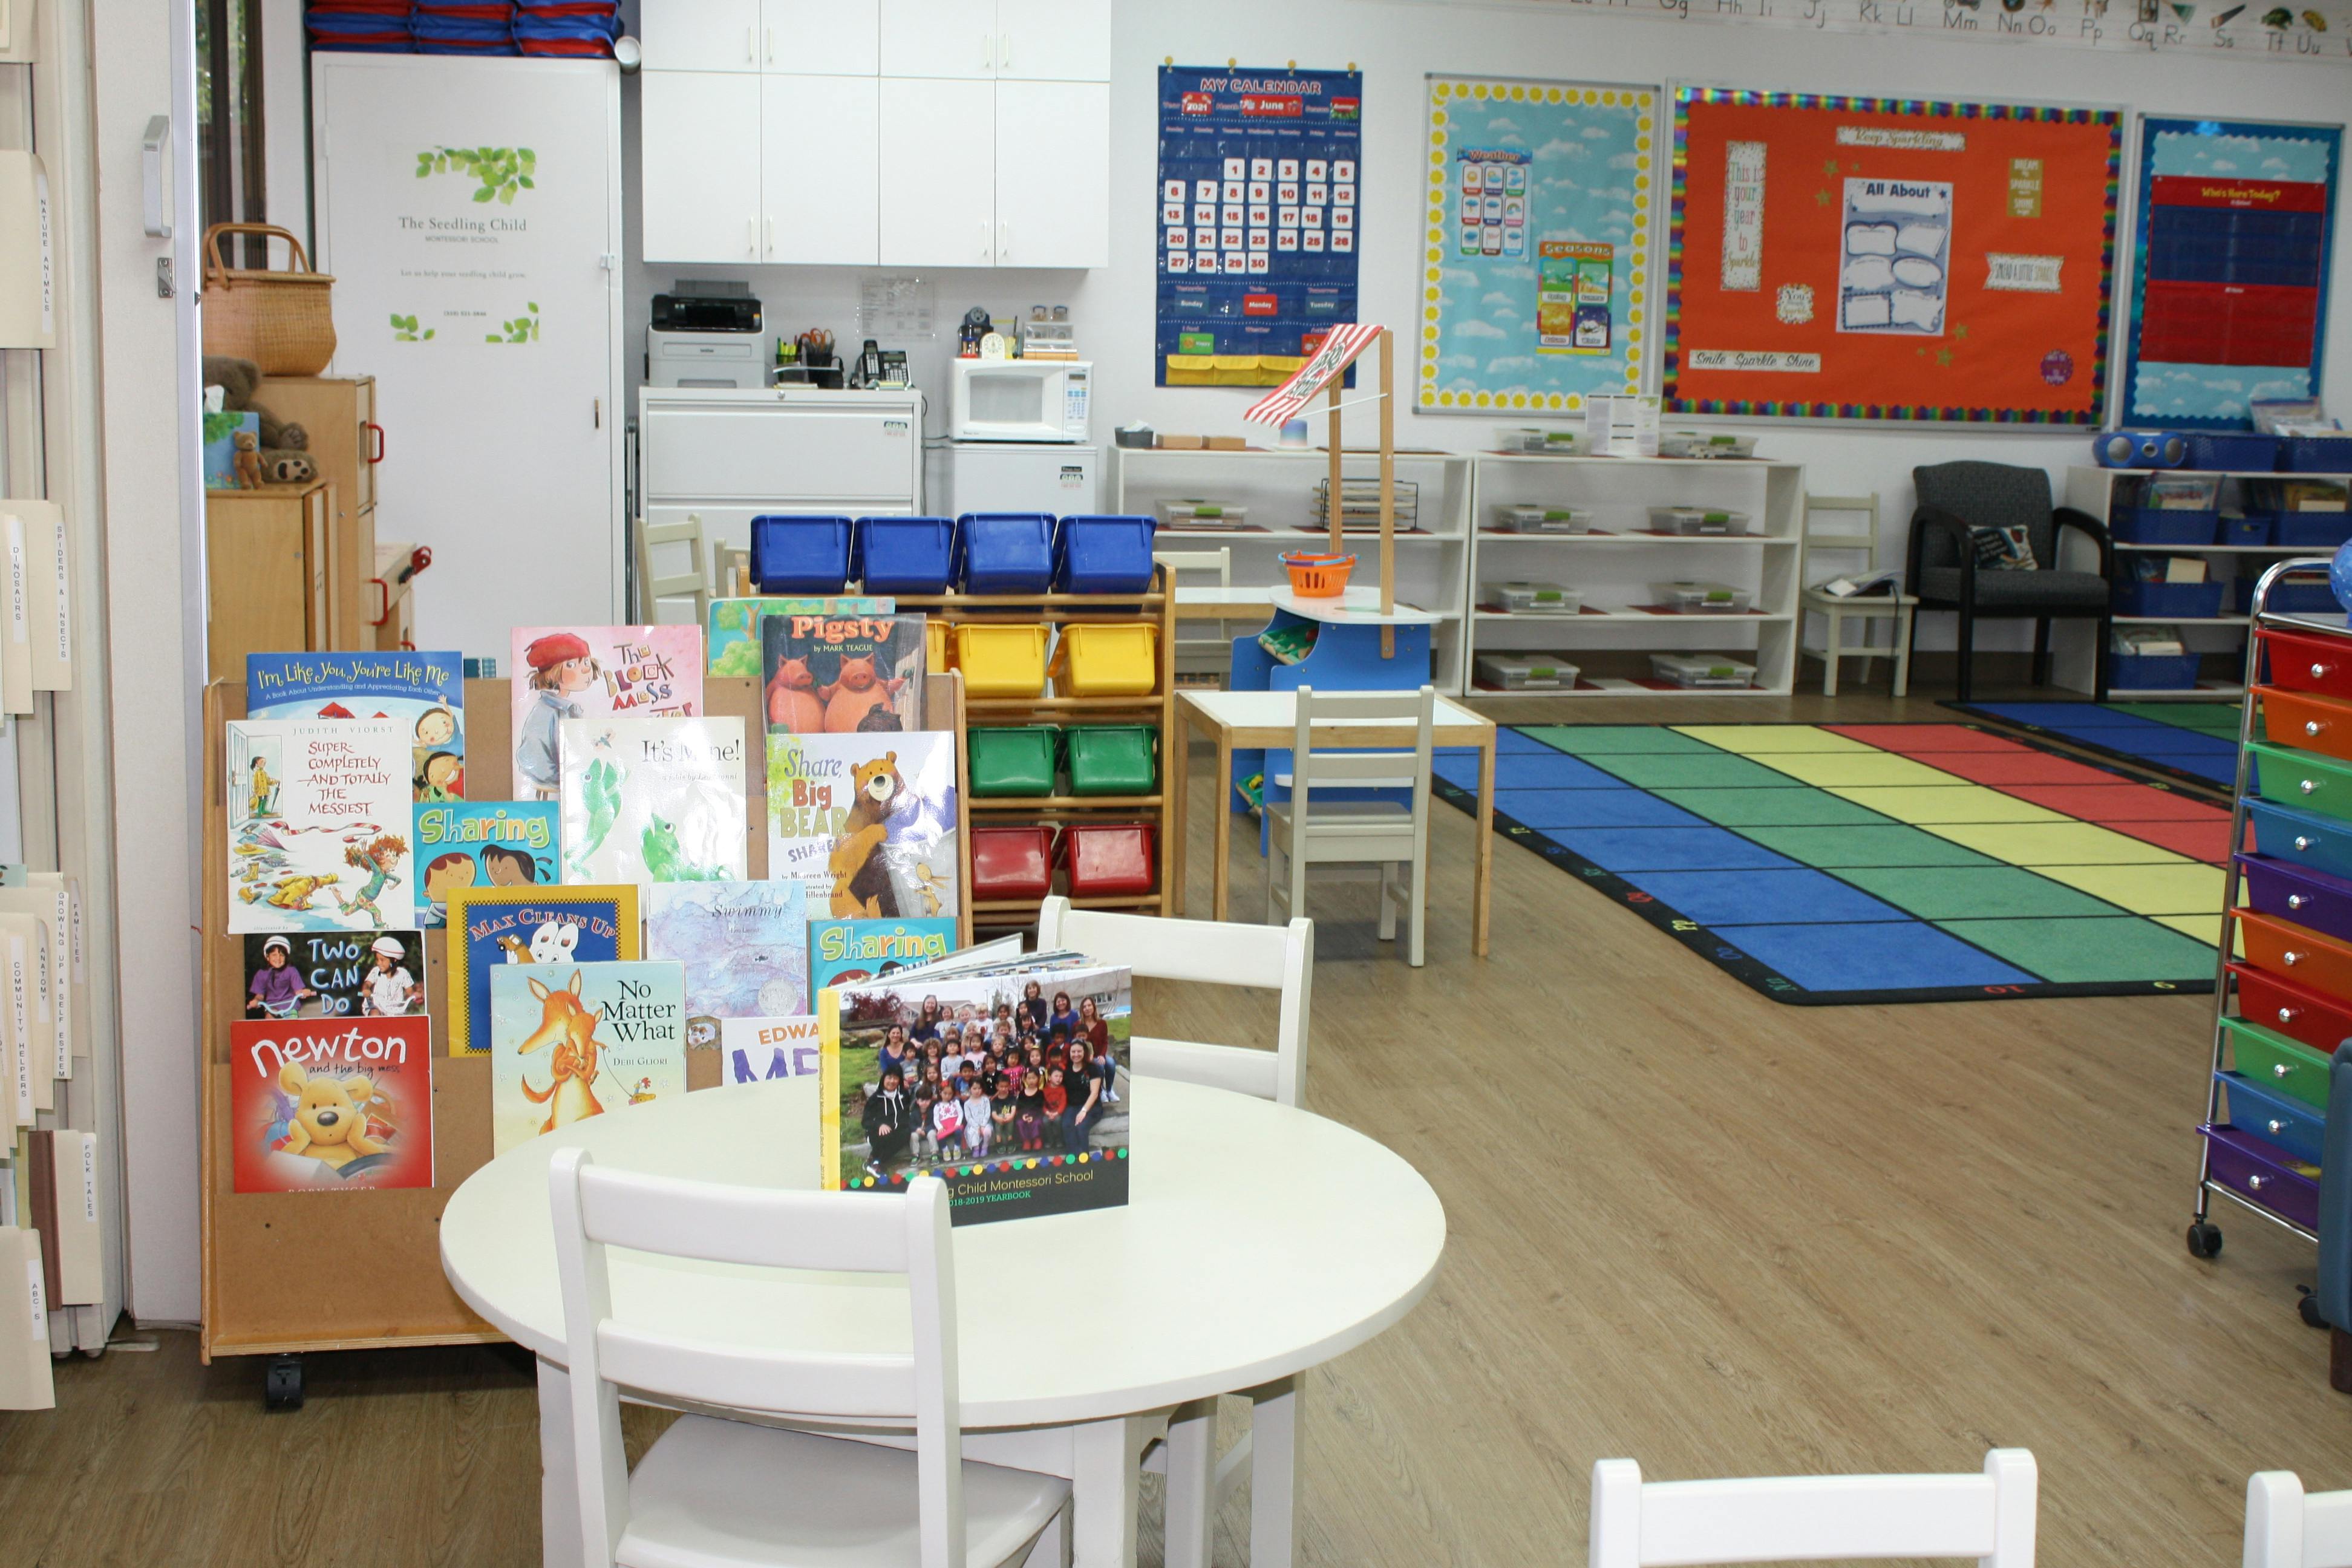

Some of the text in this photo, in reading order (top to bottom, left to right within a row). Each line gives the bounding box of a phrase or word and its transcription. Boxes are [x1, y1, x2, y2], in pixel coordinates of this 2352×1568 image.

[1859, 2, 1882, 23] Kk
[1942, 11, 1978, 30] Mm
[1998, 14, 2022, 33] Nn
[2028, 16, 2056, 36] Oo
[2080, 19, 2103, 46] Pp
[2129, 22, 2157, 51] Qq
[2163, 24, 2187, 45] Rr
[2213, 28, 2234, 48] Ss
[2265, 31, 2284, 51] Tt
[2298, 34, 2321, 55] Uu
[1200, 78, 1321, 94] MY CALENDAR
[1186, 101, 1284, 112] 2021 June
[1887, 131, 1944, 147] Sparkling
[1469, 151, 1520, 161] Weather
[1232, 165, 1348, 176] 1 2 3 4 5
[1171, 187, 1350, 200] 6 7 8 9 10 11 12
[1734, 185, 1757, 207] your
[1866, 183, 1930, 198] All About
[2201, 188, 2227, 197] Who's
[2228, 188, 2247, 198] Here
[2249, 189, 2281, 203] Today?
[1167, 210, 1348, 223] 13 14 15 16 17 18 19
[1734, 209, 1754, 231] year
[399, 217, 527, 234] The Seedling Child
[1170, 235, 1348, 246] 20 21 22 23 24 25 26
[1739, 232, 1748, 252] to
[1546, 244, 1612, 255] Seasons
[1171, 258, 1265, 268] 27 28 29 30
[1181, 299, 1334, 310] Sunday Monday Tuesday
[1695, 351, 1815, 370] Smile Sparkle Shine
[13, 547, 22, 621] DINOSAURS
[791, 616, 895, 644] Pigsty
[613, 643, 651, 665] The
[258, 661, 450, 689] I'm Like You, You're Like Me
[289, 688, 307, 697] About
[308, 684, 353, 693] Understanding
[367, 683, 407, 692] Appreciating
[293, 727, 339, 736] JUDITH
[308, 741, 354, 756] SUPER-
[641, 740, 673, 762] It's
[308, 756, 381, 771] COMPLETELY
[785, 748, 843, 779] Share,
[298, 773, 392, 786] AND TOTALLY
[319, 789, 347, 800] THE
[792, 780, 832, 811] Big
[308, 802, 374, 816] MESSIEST
[419, 808, 551, 849] Sharing
[779, 807, 848, 838] BEAR
[823, 871, 846, 880] Wright
[712, 904, 783, 920] Swimmy
[469, 908, 616, 942] MAX CLEANS UP
[307, 939, 362, 963] TWO
[820, 927, 947, 961] Sharing
[58, 955, 65, 969] UP
[310, 966, 361, 990] CAN
[14, 962, 24, 1033] COMMUNITY
[618, 980, 652, 1001] No
[321, 994, 351, 1014] DO
[602, 1001, 676, 1022] Matter
[612, 1021, 676, 1042] What
[251, 1027, 407, 1078] newton
[613, 1056, 668, 1067] DEBI GLIORI
[309, 1063, 400, 1080] and the big mess
[958, 1180, 987, 1195] Child
[991, 1174, 1052, 1192] Montessori
[1055, 1169, 1094, 1184] School
[987, 1190, 1031, 1203] YEARBOOK
[31, 1283, 41, 1321] ABC'S
